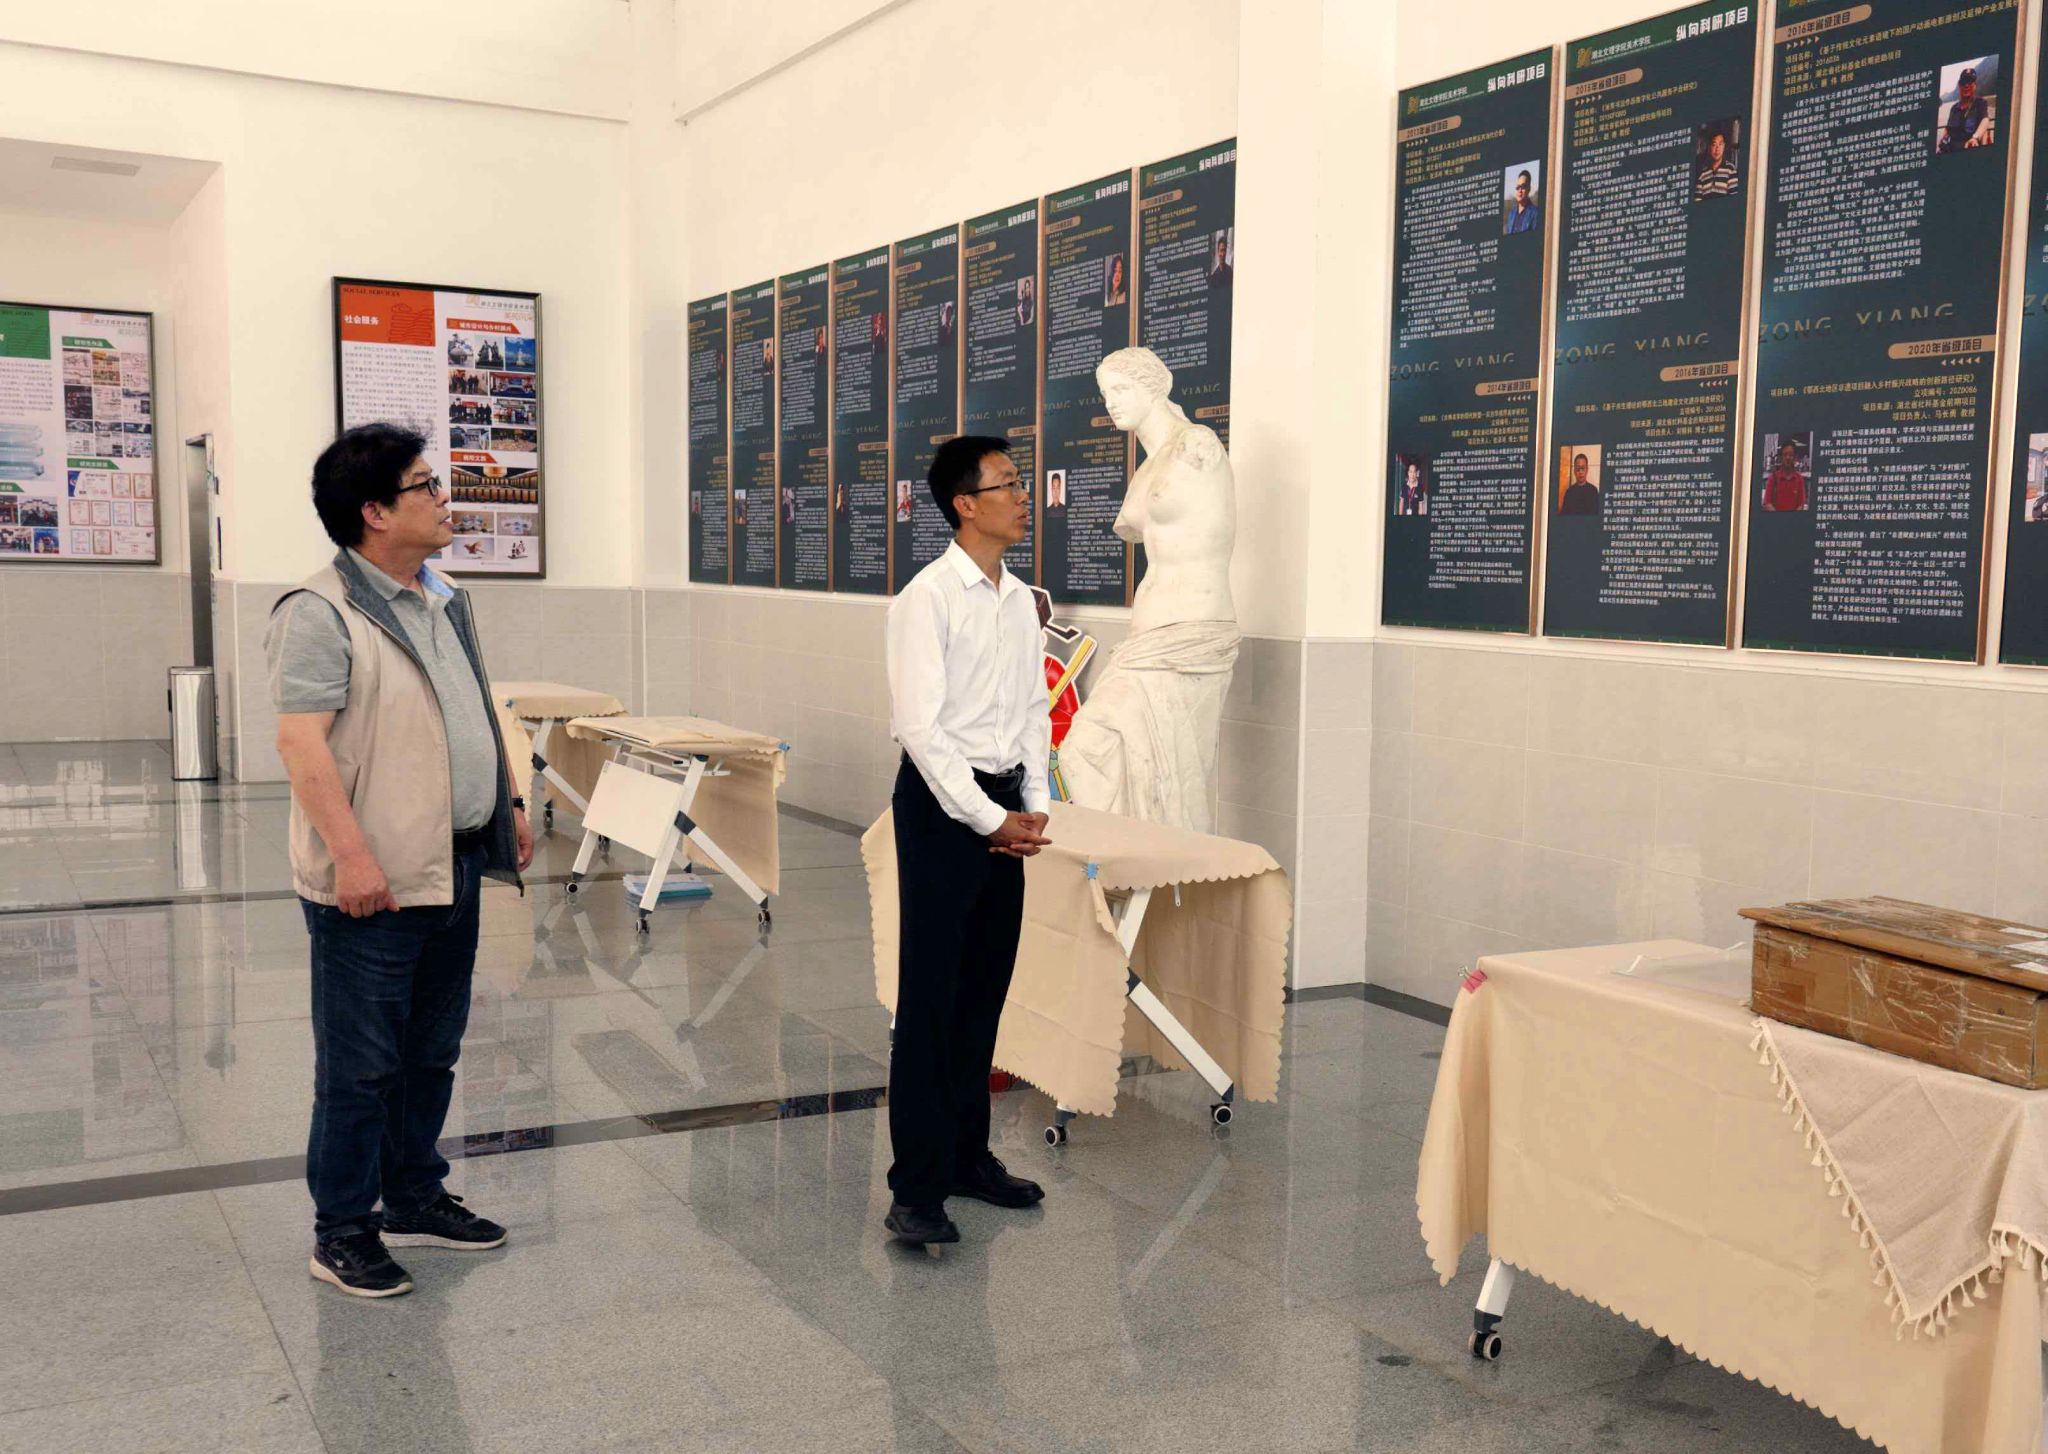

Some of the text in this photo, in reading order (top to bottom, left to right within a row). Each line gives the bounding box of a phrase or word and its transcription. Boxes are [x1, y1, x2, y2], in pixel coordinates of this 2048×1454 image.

[1590, 35, 1651, 60] 湖北文理学院美术学院
[1675, 5, 1748, 41] 纵向科研项目
[1786, 9, 1851, 39] 2016年省级项目
[1487, 63, 1545, 92] 纵向科研项目
[344, 314, 379, 325] 社会服务
[1907, 338, 1983, 356] 2020年省级项目
[1674, 363, 1728, 378] 2016年省级项目
